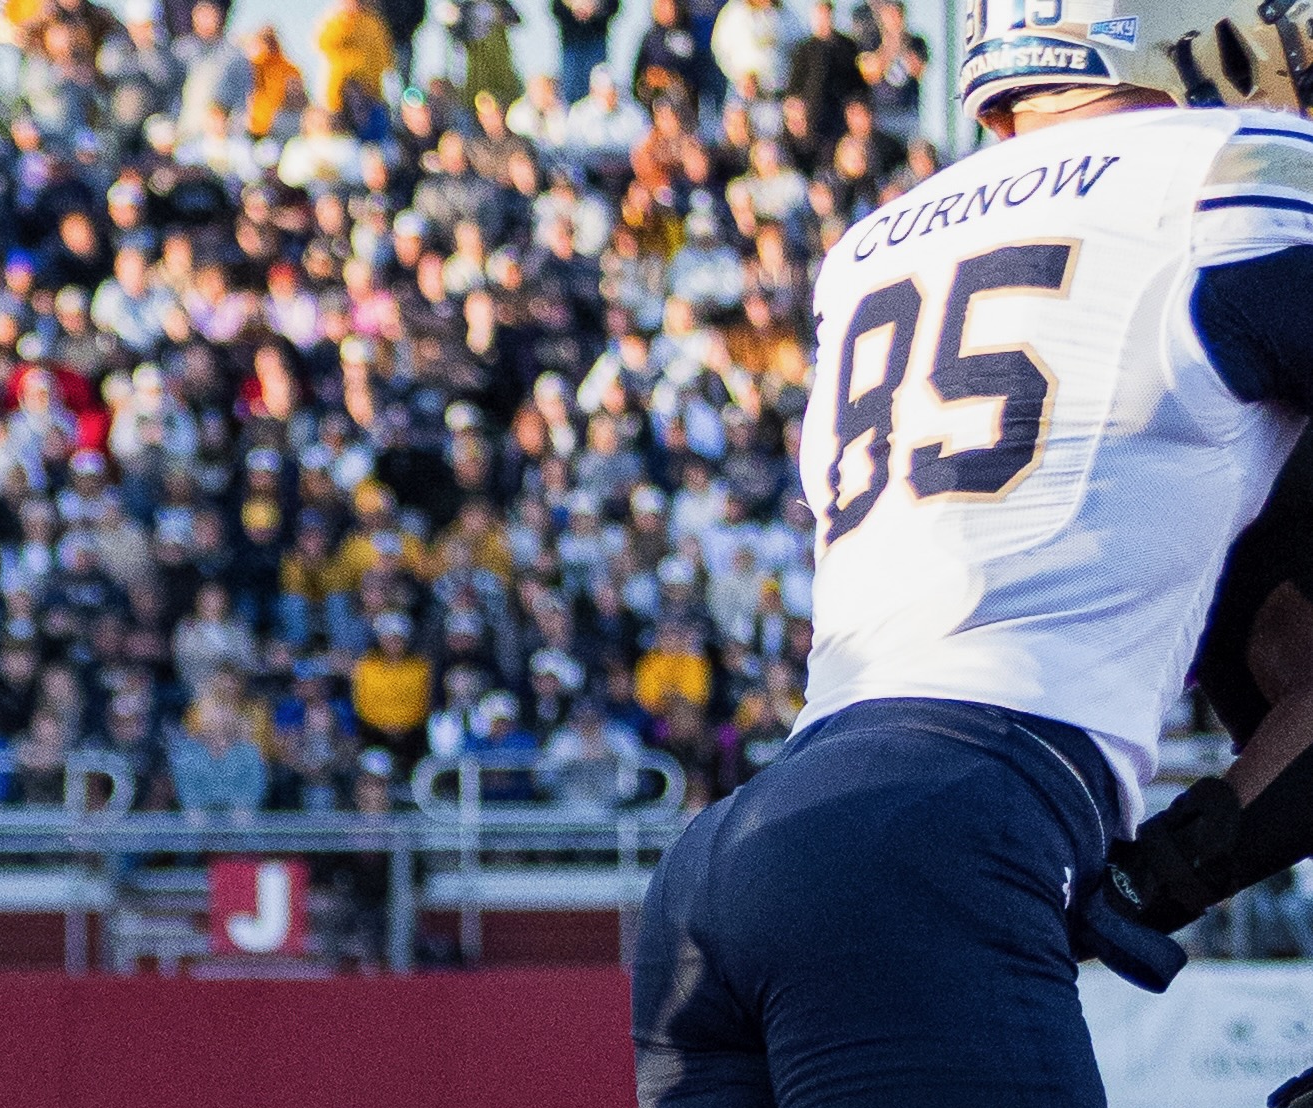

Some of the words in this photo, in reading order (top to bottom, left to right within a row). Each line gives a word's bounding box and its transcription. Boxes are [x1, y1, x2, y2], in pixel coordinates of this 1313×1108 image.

[853, 155, 1120, 263] CURNOW
[824, 237, 1084, 552] 85
[227, 860, 290, 952] J
